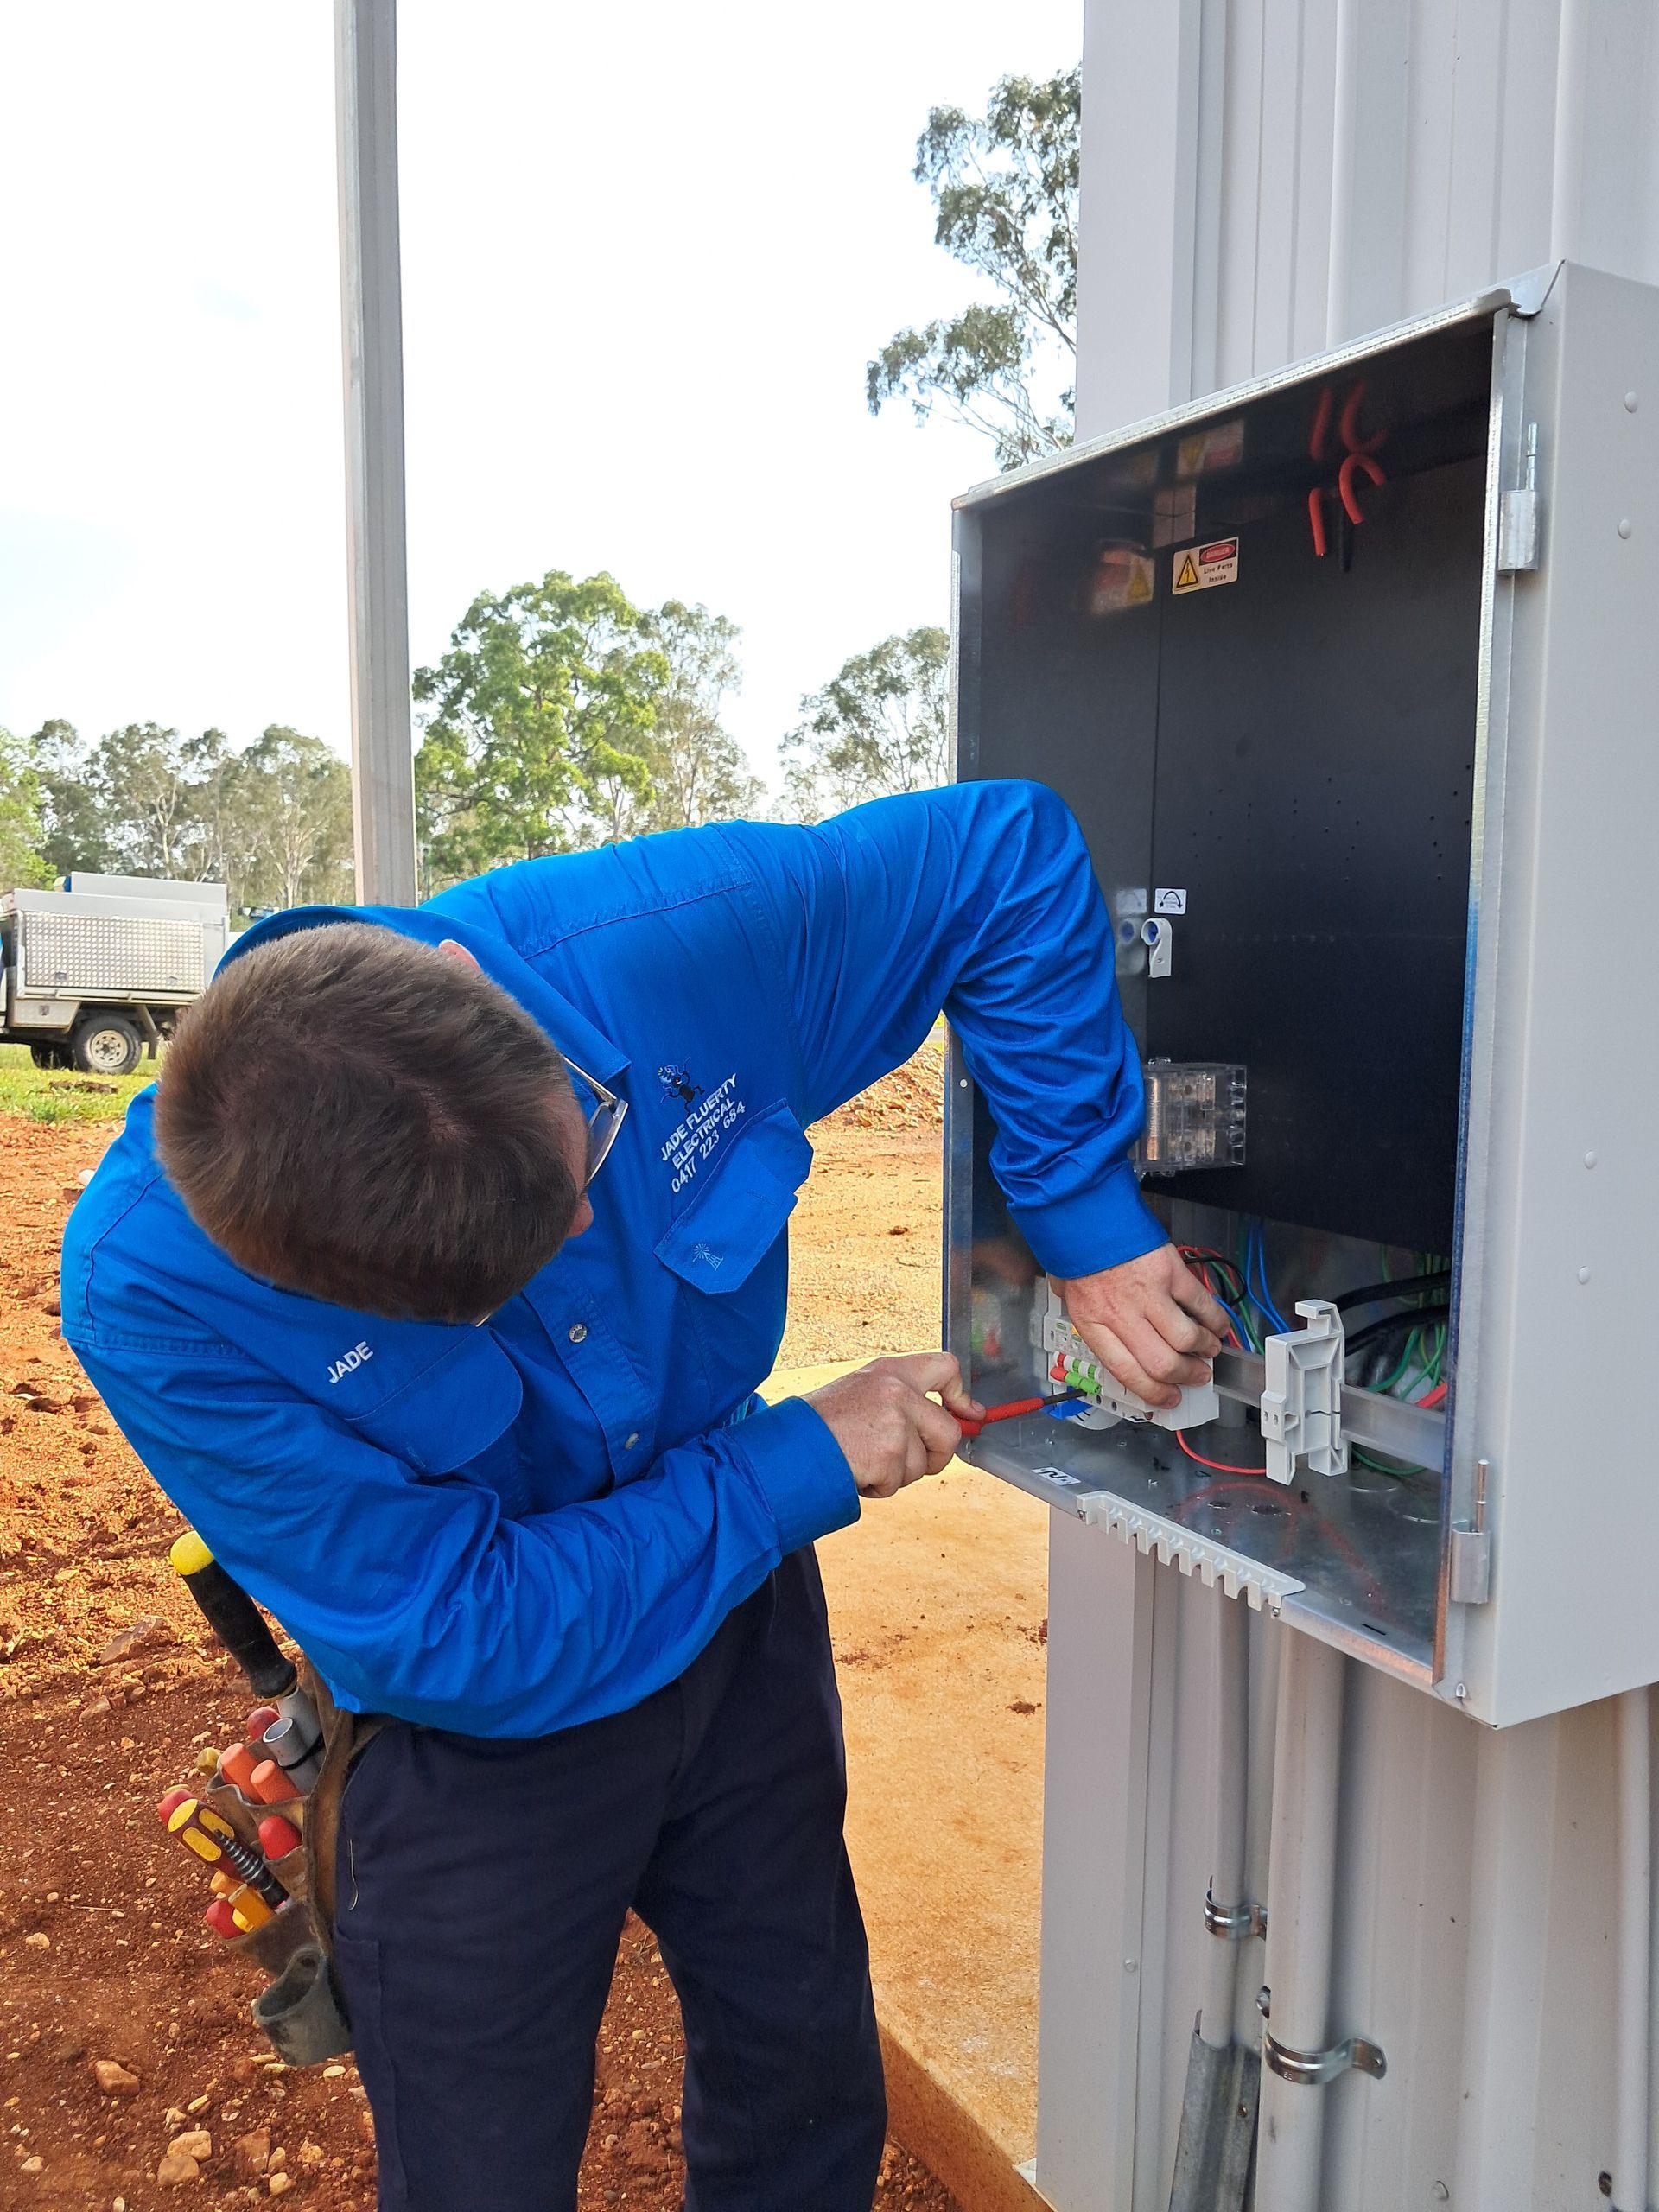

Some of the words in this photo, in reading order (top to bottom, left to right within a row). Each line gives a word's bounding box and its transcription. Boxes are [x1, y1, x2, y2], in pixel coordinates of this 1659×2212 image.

[661, 1123, 688, 1161] JADE
[685, 1073, 737, 1130] FLUERTY
[671, 1100, 734, 1170] ELECTRICAL
[671, 1156, 696, 1193] 0417
[699, 1129, 720, 1160] 223
[723, 1101, 746, 1129] 684
[327, 1341, 374, 1383] JADE
